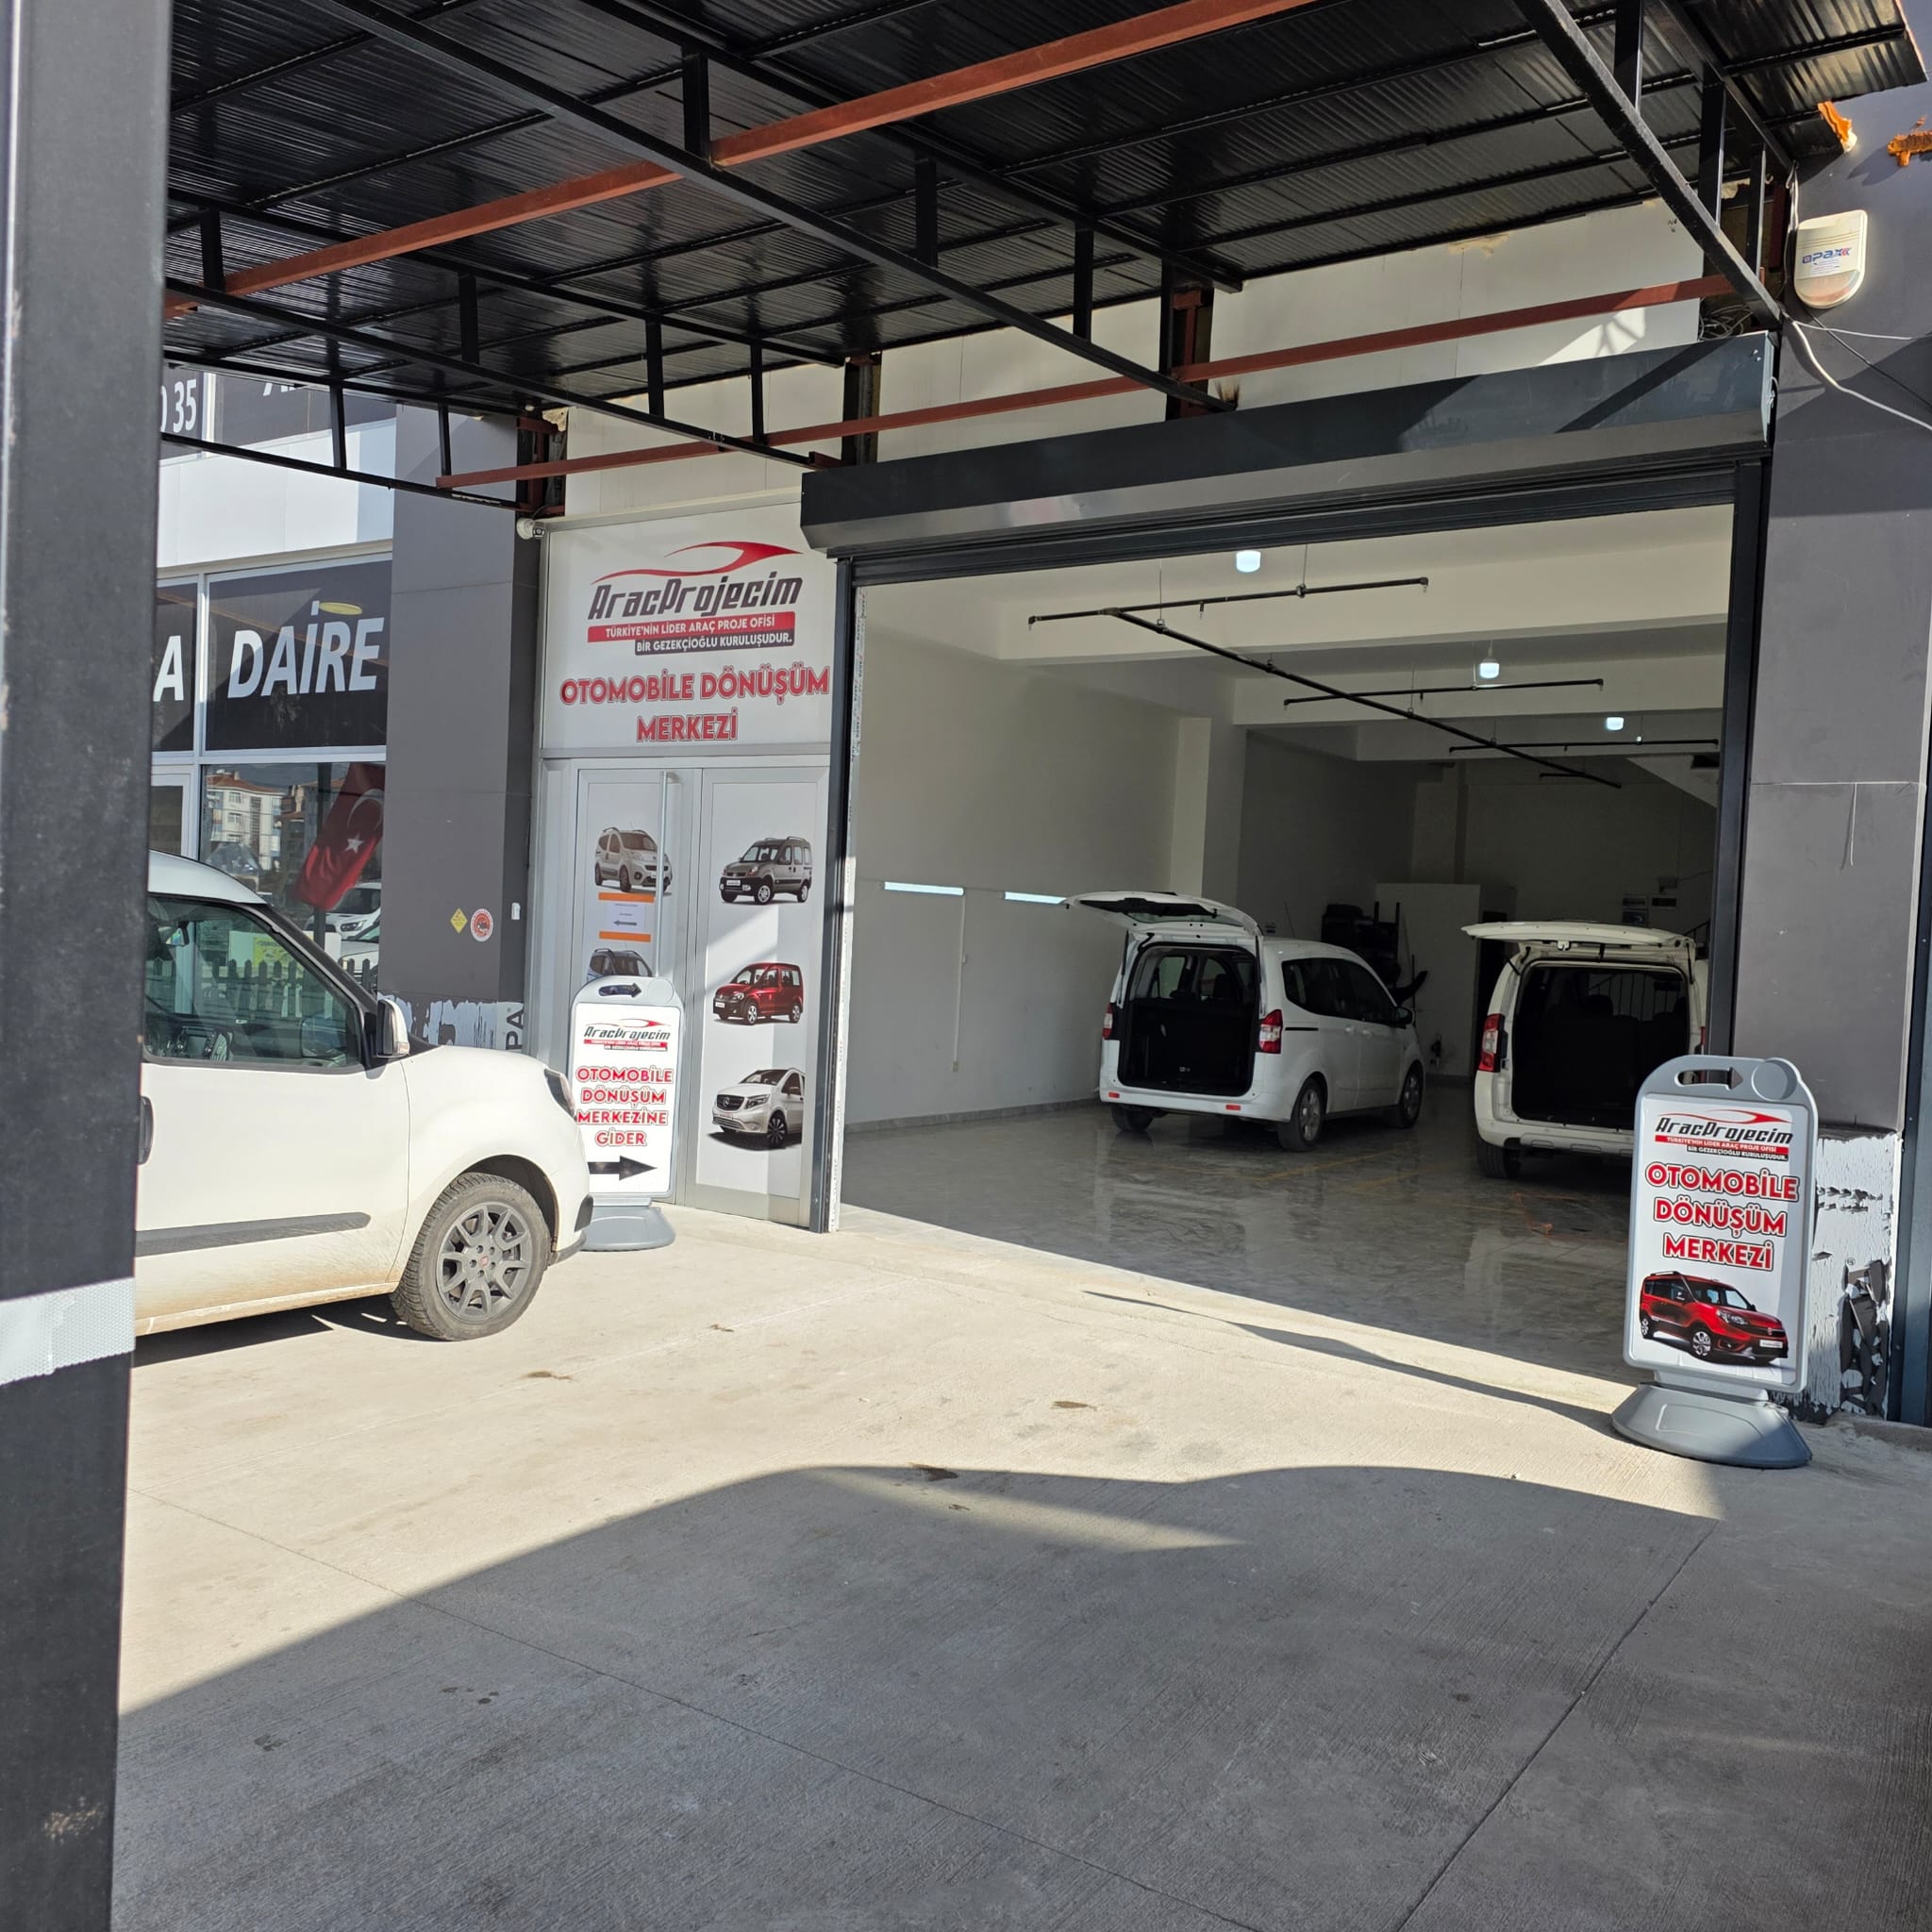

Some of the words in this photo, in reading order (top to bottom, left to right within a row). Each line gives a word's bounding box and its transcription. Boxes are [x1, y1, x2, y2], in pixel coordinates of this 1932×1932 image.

[173, 378, 197, 433] 35
[587, 571, 804, 621] AracProjecim
[605, 624, 659, 639] TÜRKİYE'NİN
[660, 622, 687, 635] LİDER
[688, 620, 716, 634] ARAÇ
[717, 617, 748, 630] PROJE
[749, 614, 775, 628] OFİSİ
[227, 600, 385, 699] DAİRE
[636, 639, 651, 653] BİR
[653, 636, 719, 653] GEZEKÇİOĞLU
[720, 632, 793, 648] KURULUŞUDUR.
[559, 668, 695, 706] OTOMOBİLE
[699, 660, 831, 706] DÖNÜŞÜM
[636, 707, 739, 743] MERKEZİ
[583, 1025, 671, 1041] AracProjecim
[575, 1064, 674, 1084] OTOMOBİLE
[581, 1085, 666, 1108] DÖNÜŞÜM
[575, 1106, 668, 1125] MERKEZİNE
[1655, 1117, 1793, 1144] AracProjecim
[594, 1126, 648, 1147] GİDER
[1645, 1161, 1800, 1203] OTOMOBİLE
[1654, 1194, 1788, 1239] DÖNÜŞÜM
[1662, 1232, 1774, 1272] MERKEZİ
